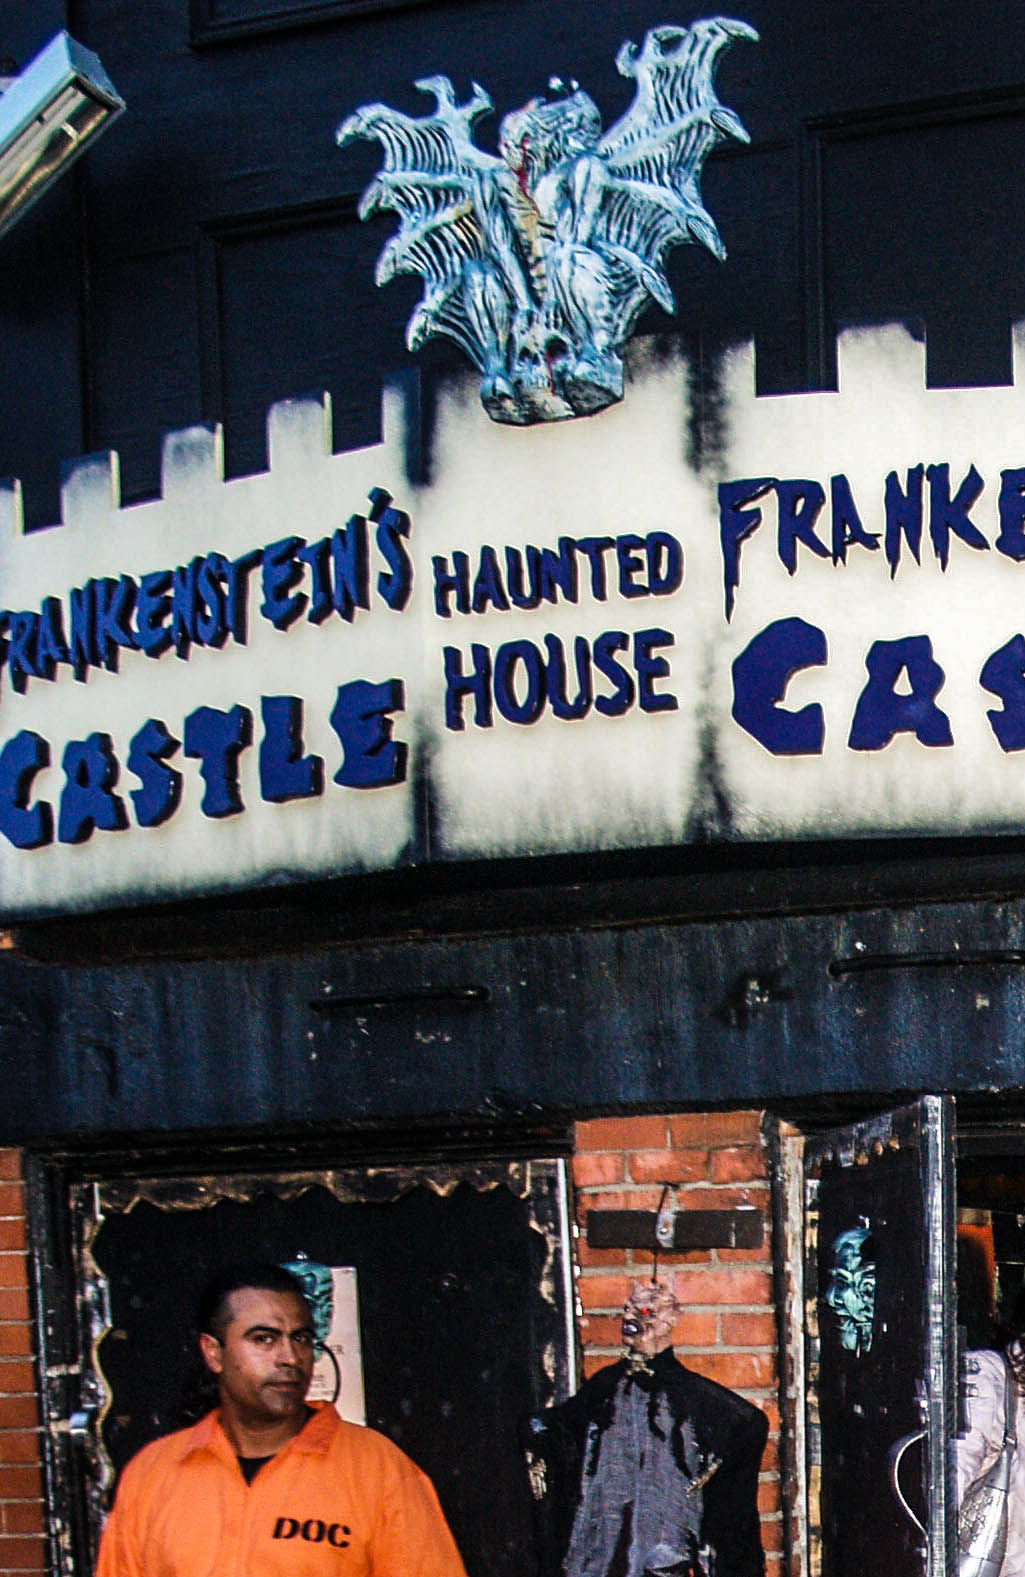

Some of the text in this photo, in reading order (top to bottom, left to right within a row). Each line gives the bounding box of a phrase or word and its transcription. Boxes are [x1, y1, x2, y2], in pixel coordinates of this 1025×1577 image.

[432, 531, 685, 618] HAUNTED
[443, 628, 679, 731] HOUSE
[0, 678, 409, 850] CASTLE
[272, 1516, 351, 1548] DOC
